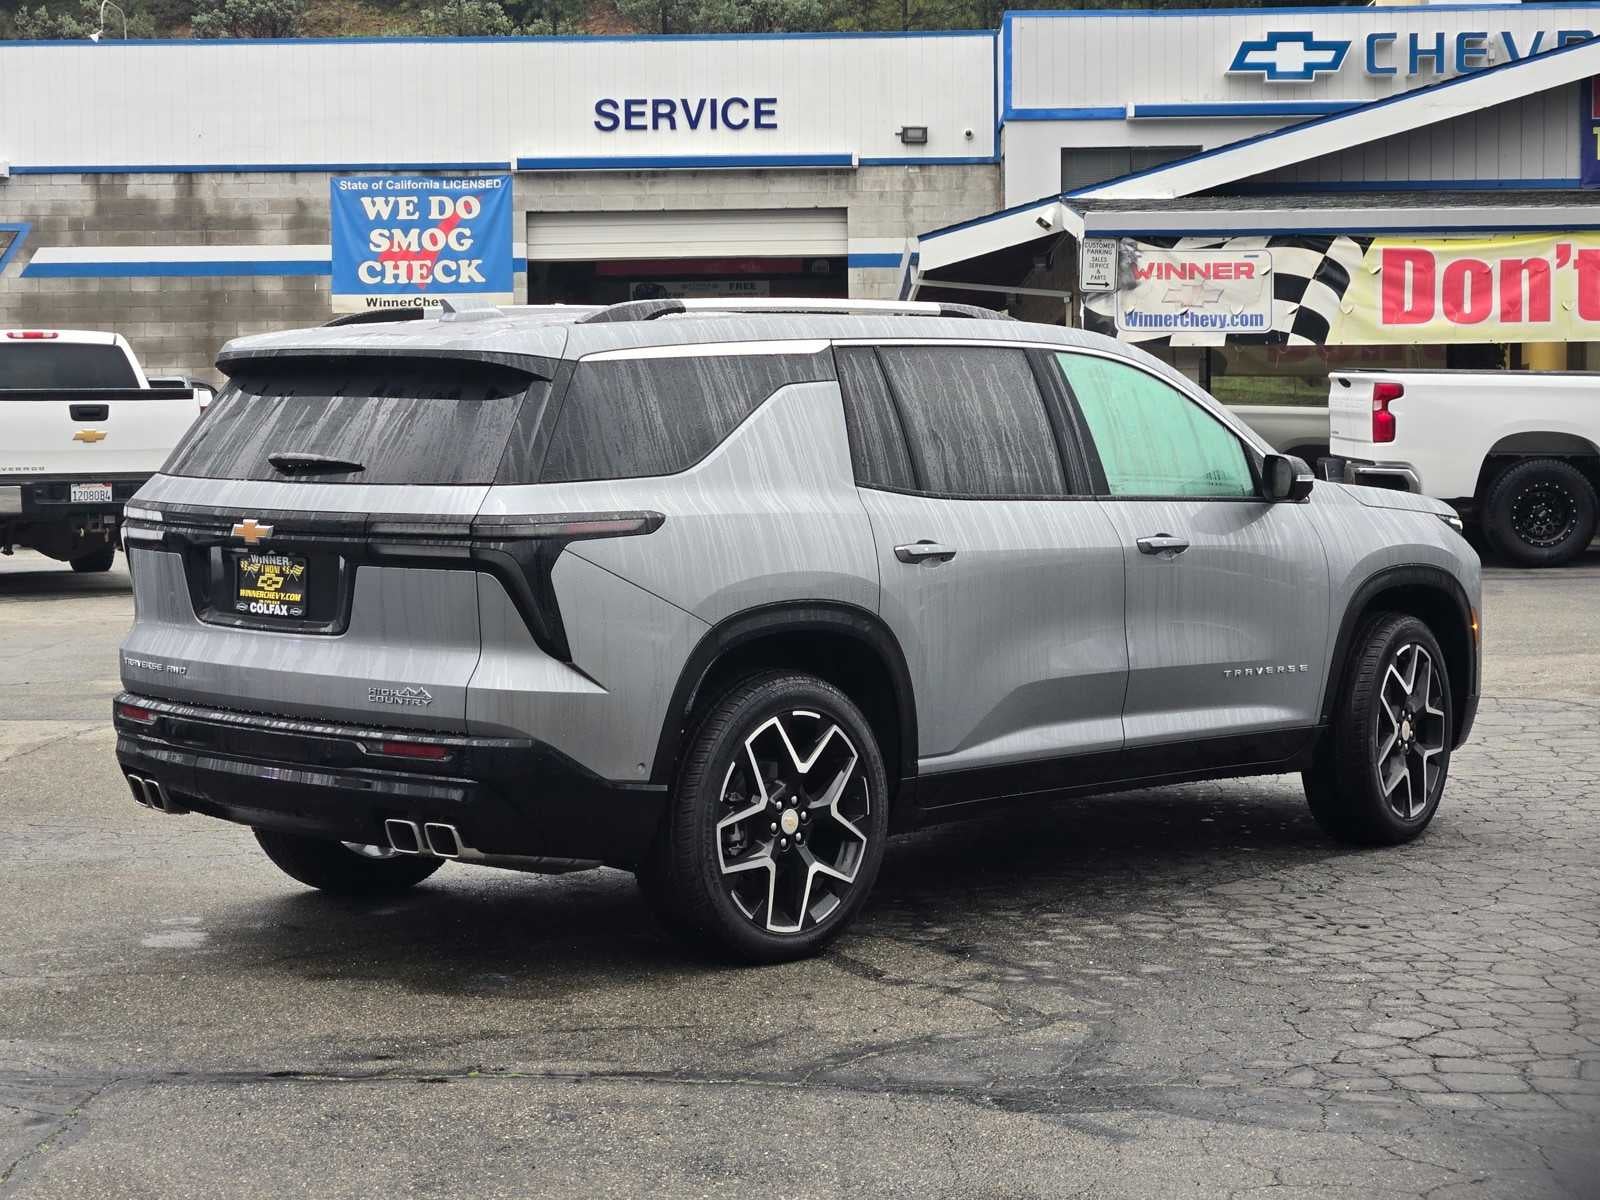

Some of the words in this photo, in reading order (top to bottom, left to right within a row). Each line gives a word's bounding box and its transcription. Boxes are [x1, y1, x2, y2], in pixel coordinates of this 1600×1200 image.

[594, 97, 778, 131] SERVICE
[340, 180, 369, 190] State
[372, 179, 383, 189] of
[386, 178, 440, 189] California
[443, 178, 502, 189] LICENSED
[360, 196, 420, 220] WE
[428, 196, 481, 219] DO
[369, 228, 474, 252] SMOG
[358, 259, 486, 284] CHECK
[1131, 262, 1255, 280] WINNER
[366, 297, 444, 307] WinnerChe
[1124, 311, 1264, 328] WinnerChevy.com
[250, 554, 289, 565] WINNER
[240, 589, 301, 601] WINNERCHEVY.COM
[250, 602, 288, 616] COLFAX
[1223, 664, 1309, 677] TRAVERSE
[368, 687, 401, 696] HIGH
[368, 695, 433, 705] COUNTRY
